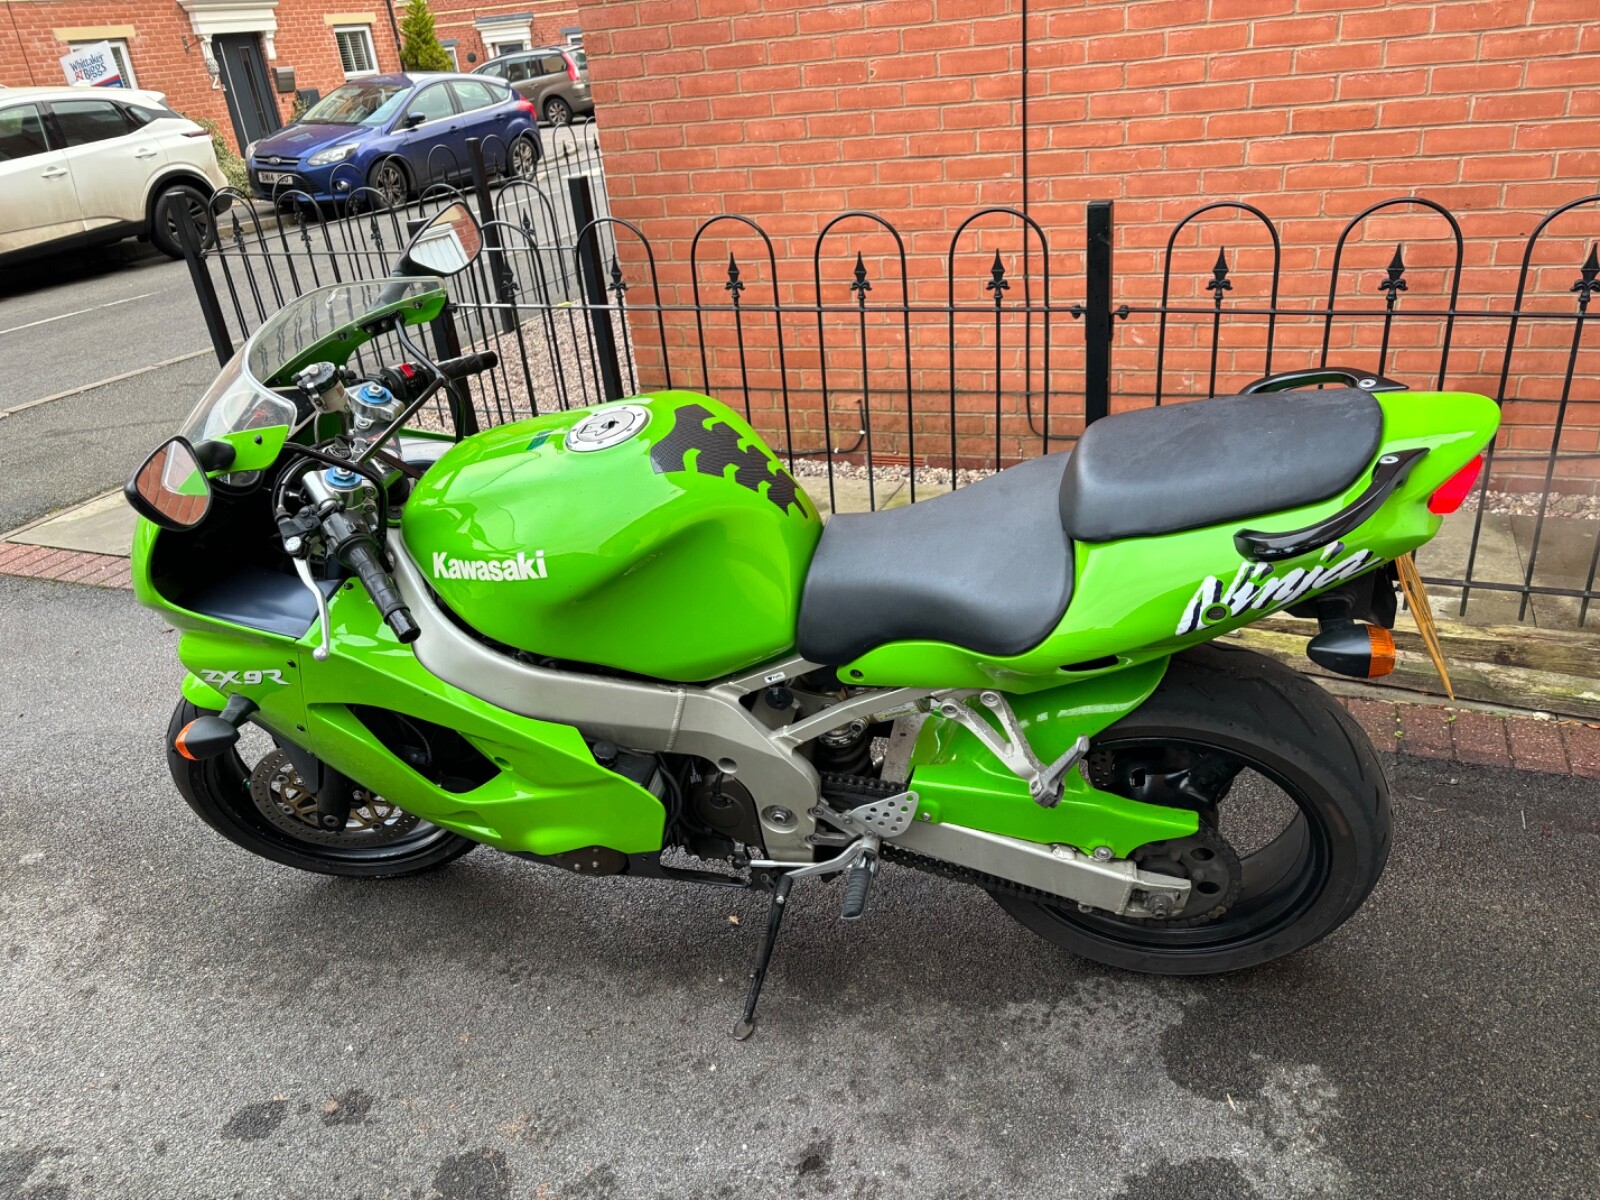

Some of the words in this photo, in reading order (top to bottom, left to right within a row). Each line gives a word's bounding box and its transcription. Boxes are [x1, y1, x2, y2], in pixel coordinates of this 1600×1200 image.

[69, 53, 104, 71] Whittaker
[83, 63, 107, 81] Biggs
[432, 550, 548, 581] Kawasaki
[1175, 541, 1383, 635] Ninja
